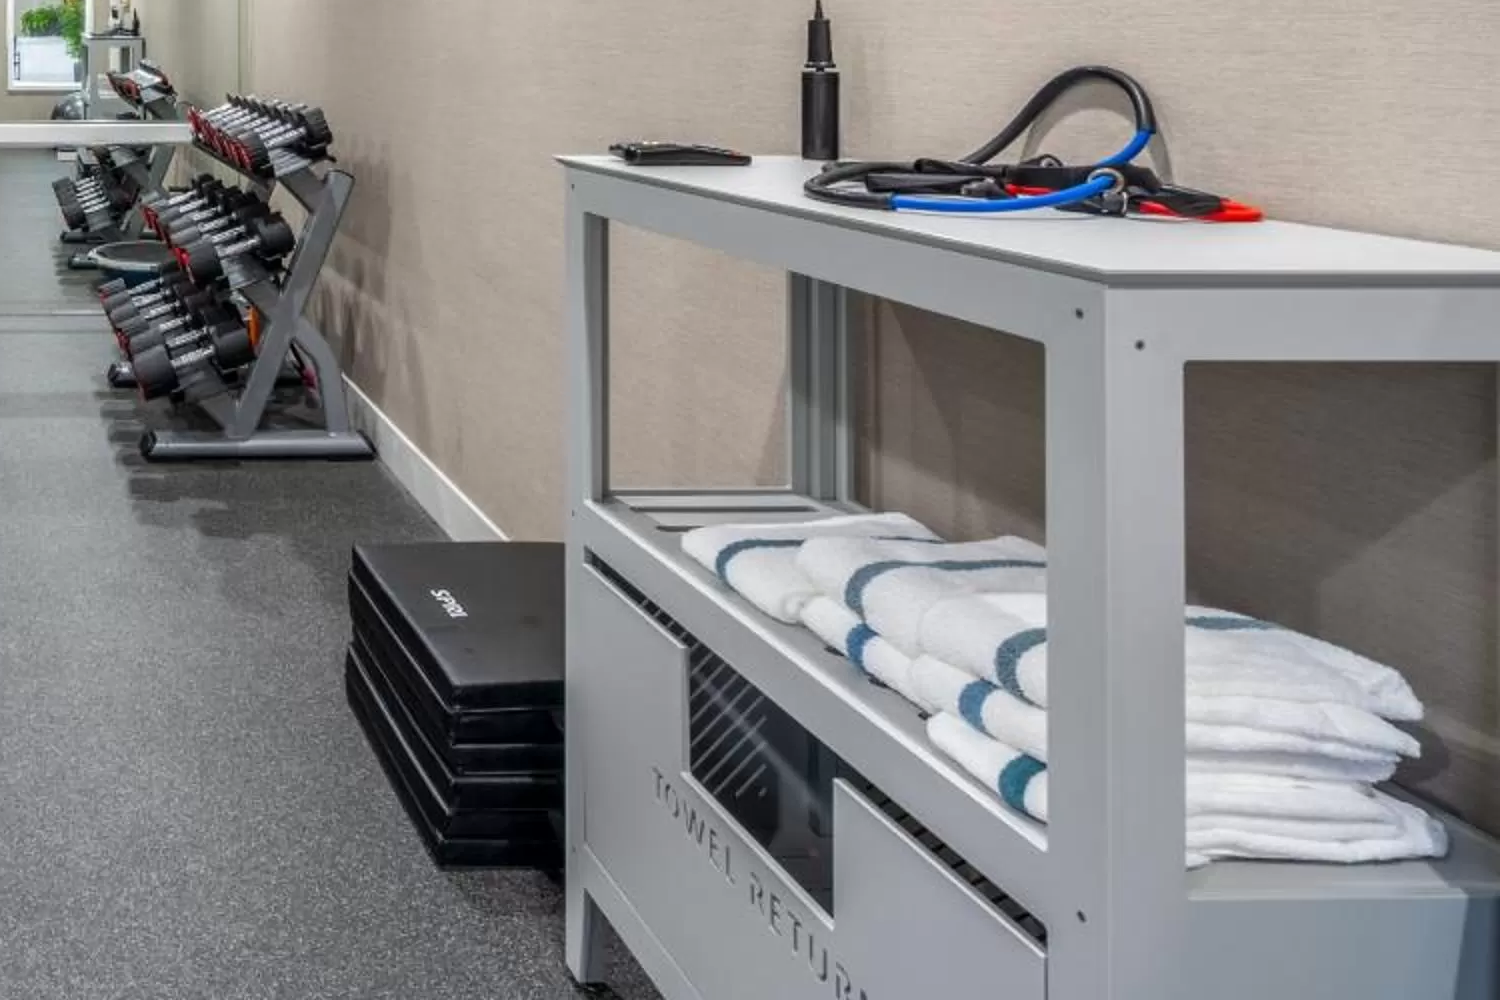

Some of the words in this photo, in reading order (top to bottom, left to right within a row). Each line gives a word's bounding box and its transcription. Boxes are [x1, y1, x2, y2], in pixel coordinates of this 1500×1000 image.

[429, 588, 469, 619] SPRI
[652, 764, 736, 887] TOWEL
[750, 871, 868, 1000] RETUR
